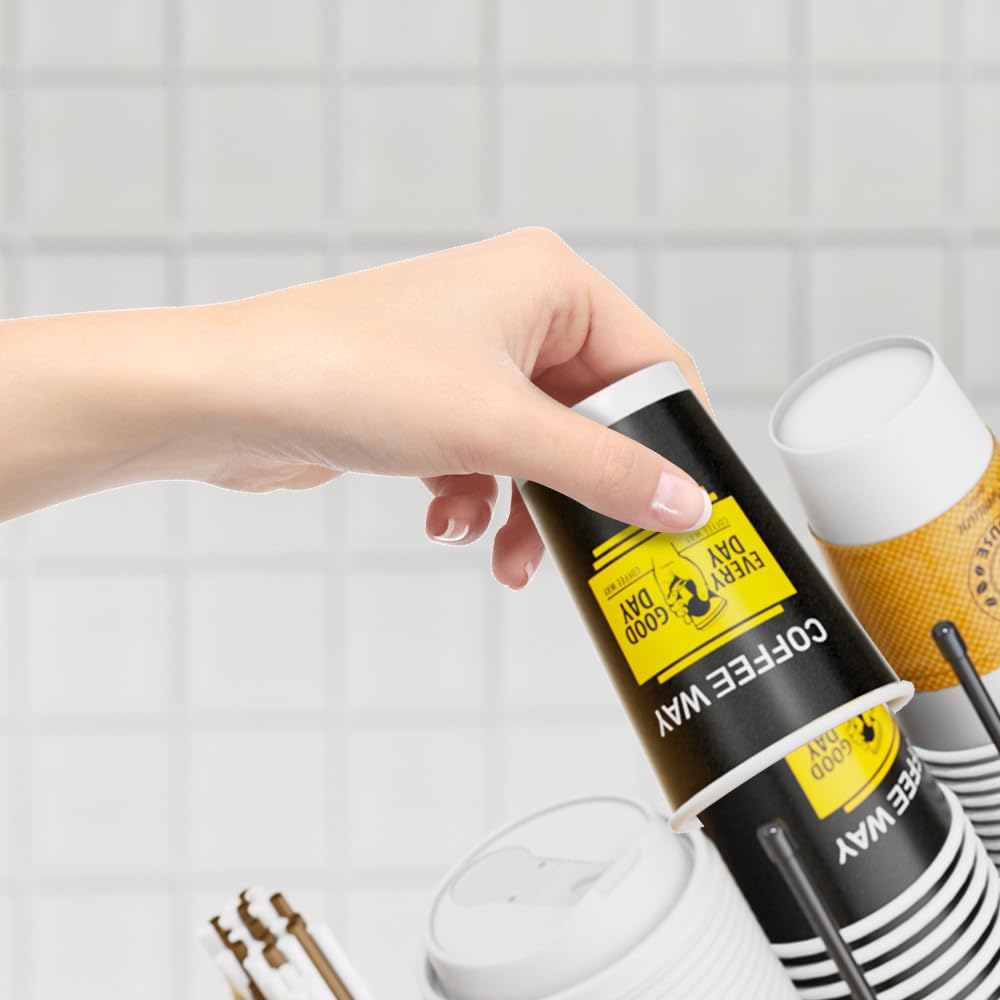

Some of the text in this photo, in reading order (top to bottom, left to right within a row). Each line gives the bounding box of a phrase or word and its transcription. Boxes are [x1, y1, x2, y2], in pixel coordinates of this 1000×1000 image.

[706, 534, 746, 569] DAY
[711, 550, 766, 592] EVERY
[619, 587, 654, 625] DAY
[624, 606, 669, 646] GOOD
[654, 617, 828, 738] COFFEE WAY
[810, 738, 851, 781] GOOD
[835, 806, 896, 866] WAY
